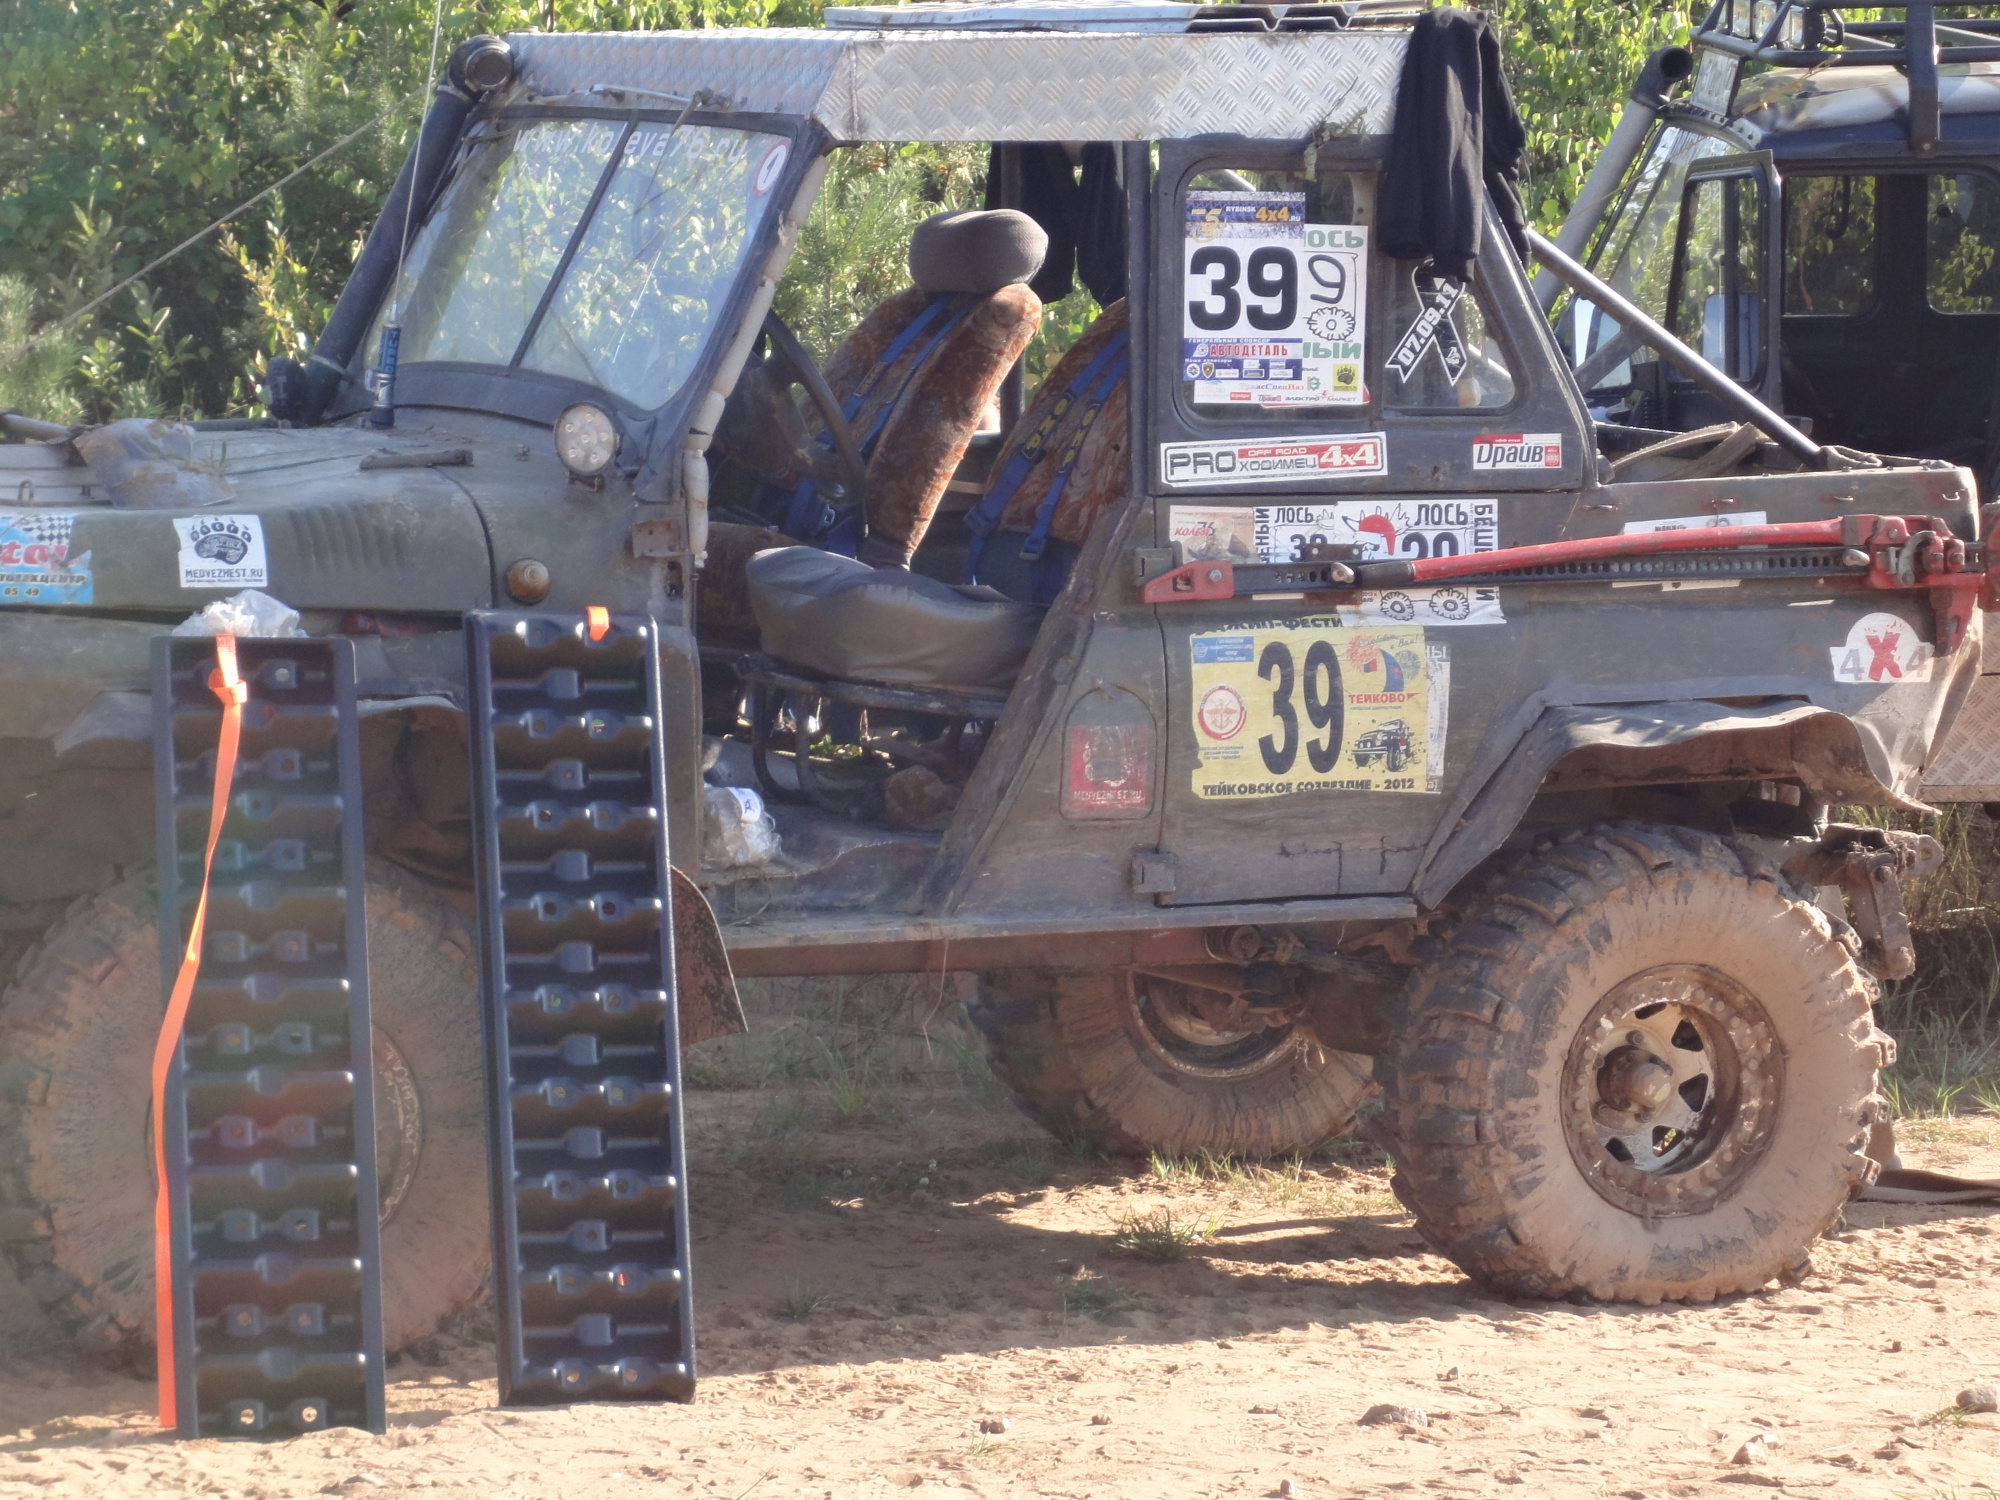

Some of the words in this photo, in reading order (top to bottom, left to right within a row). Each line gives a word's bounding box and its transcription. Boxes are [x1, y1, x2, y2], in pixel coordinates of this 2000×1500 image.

[1202, 208, 1222, 232] 5
[1256, 206, 1289, 222] 4x4
[1303, 229, 1364, 249] ОСЬ
[1188, 245, 1299, 332] 39
[1397, 282, 1459, 366] 07.09.11
[1210, 344, 1289, 358] АВТОДЕТАЛЬ
[1248, 449, 1272, 457] OFF
[1275, 447, 1307, 455] ROAD
[1319, 444, 1376, 467] 4x4
[1169, 450, 1237, 476] PRO
[1274, 506, 1314, 524] ЛОСЬ
[1414, 502, 1469, 526] ЛОСЬ
[185, 568, 264, 579] MEDVEZHEST.RU
[25, 587, 40, 597] 49
[1257, 640, 1345, 775] 39
[1203, 781, 1293, 797] ТЕЙКОВСКОЕ
[1384, 778, 1415, 790] 2012
